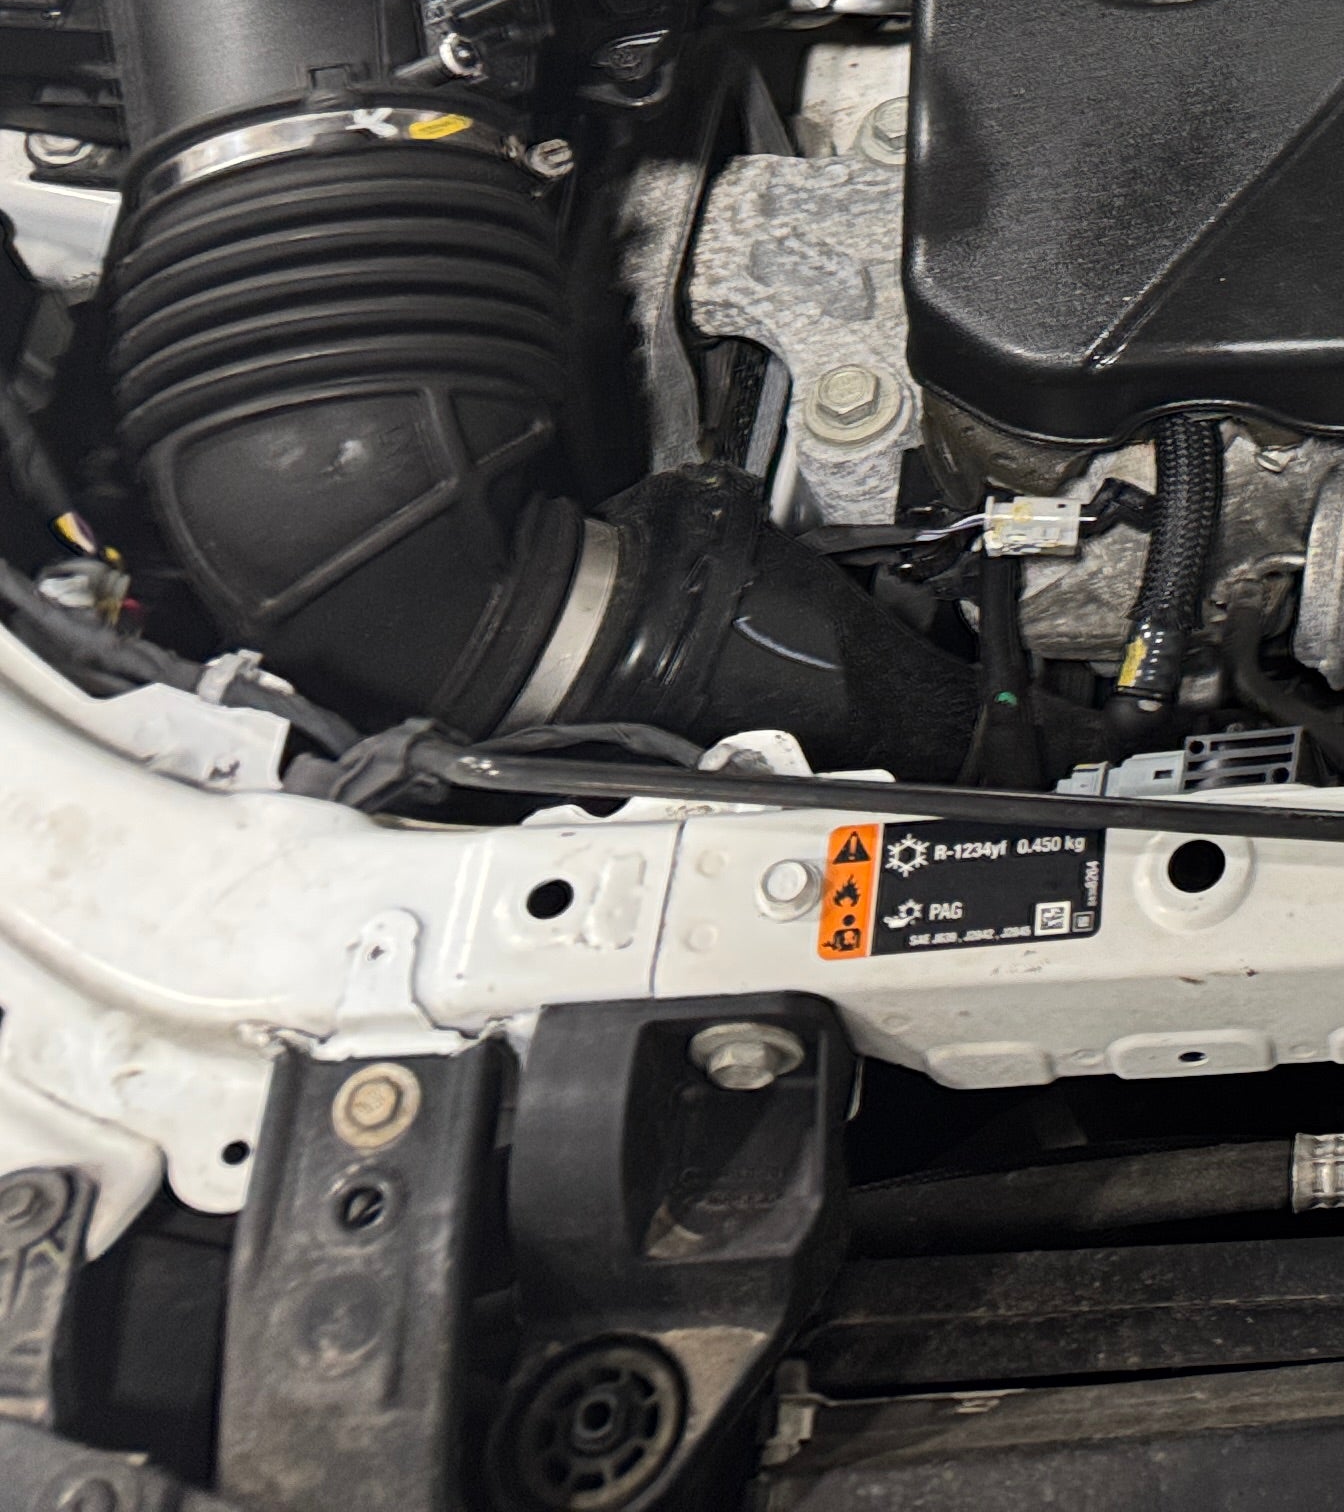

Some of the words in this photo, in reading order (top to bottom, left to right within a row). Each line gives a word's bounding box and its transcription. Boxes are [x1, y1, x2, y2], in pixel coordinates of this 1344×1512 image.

[933, 840, 1007, 860] R-1234yf
[1016, 836, 1061, 854] 0.450
[1064, 835, 1086, 852] kg
[928, 901, 963, 920] PAG
